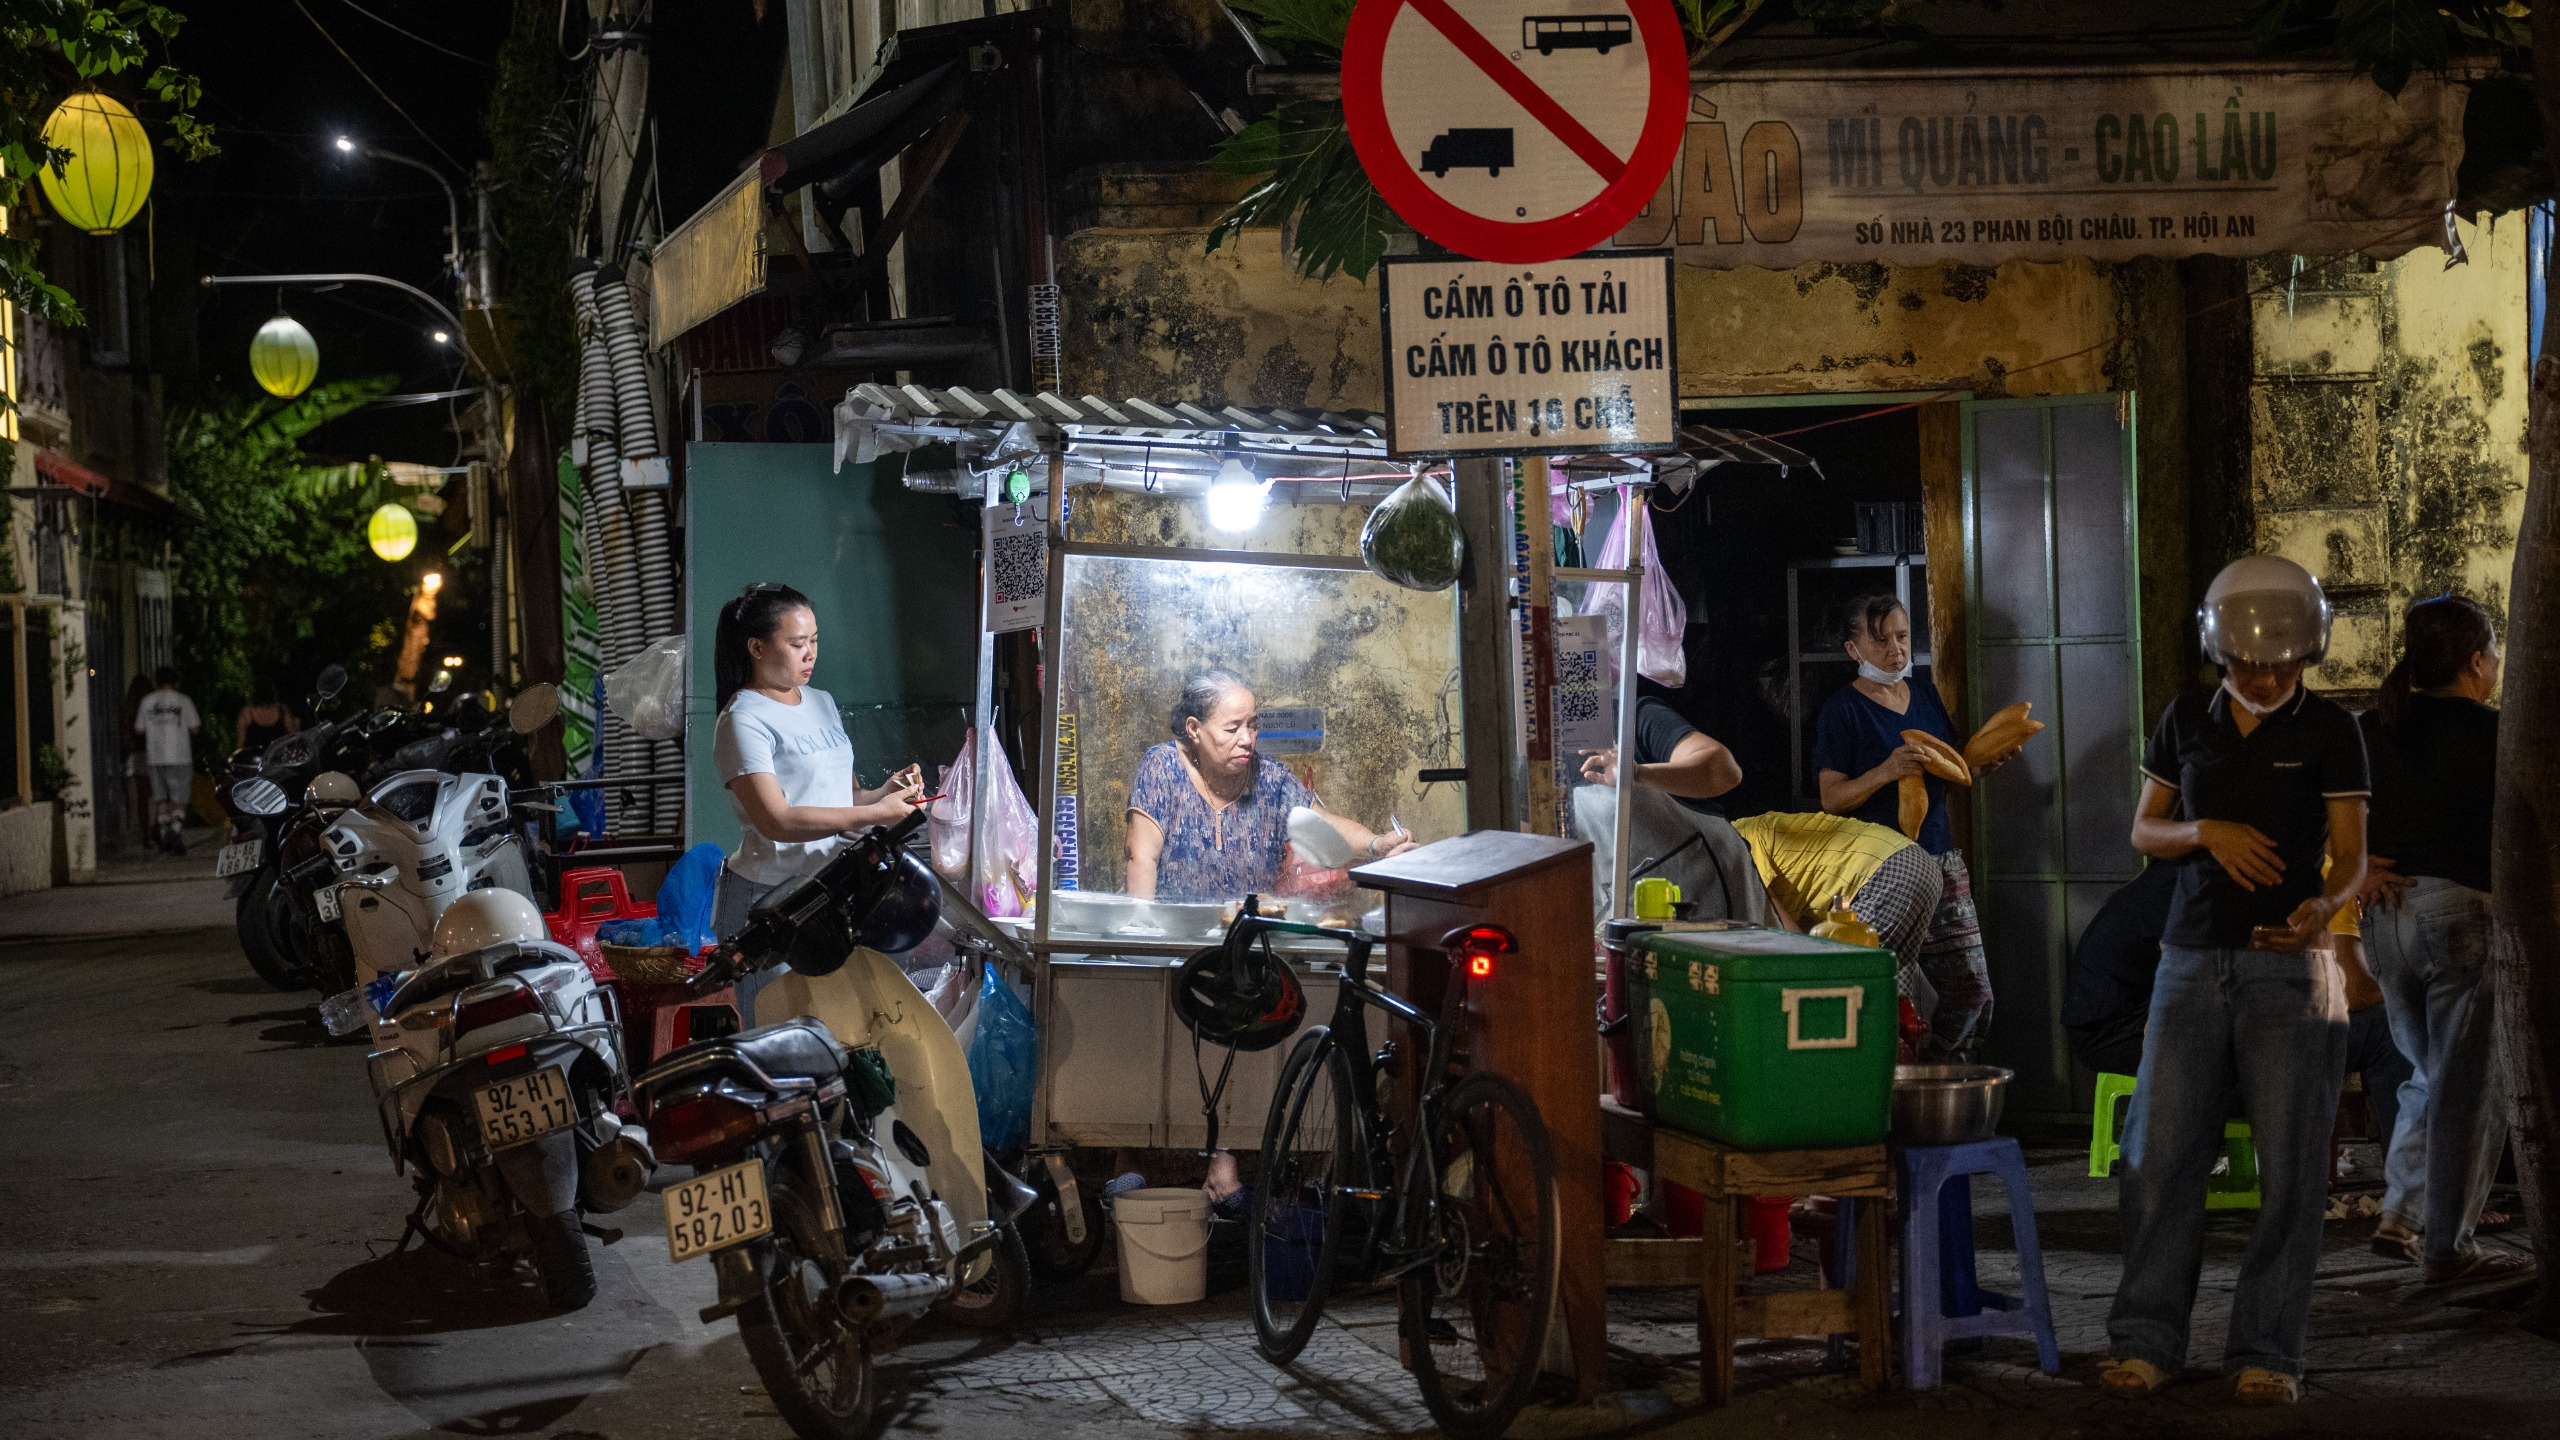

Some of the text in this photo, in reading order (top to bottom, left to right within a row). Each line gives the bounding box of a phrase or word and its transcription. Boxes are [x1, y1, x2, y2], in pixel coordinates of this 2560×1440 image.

[1899, 90, 2049, 196] QUẢNG
[2095, 112, 2180, 184] CAO
[2196, 86, 2277, 181] LẦU
[1855, 214, 1884, 244] SỐ
[1891, 217, 1934, 243] NHÀ
[1940, 220, 1966, 243] 23
[1973, 219, 2031, 243] PHAN
[2038, 213, 2073, 246] BỘI
[2149, 216, 2176, 239] TP.
[2183, 211, 2219, 243] HỘI
[2225, 215, 2255, 238] AN
[1423, 270, 1627, 320] CẤM Ô TÔ TẢI
[1406, 330, 1663, 378] CẤM Ô TÔ KHÁCH
[1437, 393, 1518, 434] TRÊN
[1528, 397, 1564, 435] 16
[487, 1073, 553, 1113] 92-H1
[487, 1098, 568, 1148] 553.17
[680, 1170, 746, 1217] 92-H1
[675, 1200, 763, 1252] 582.03
